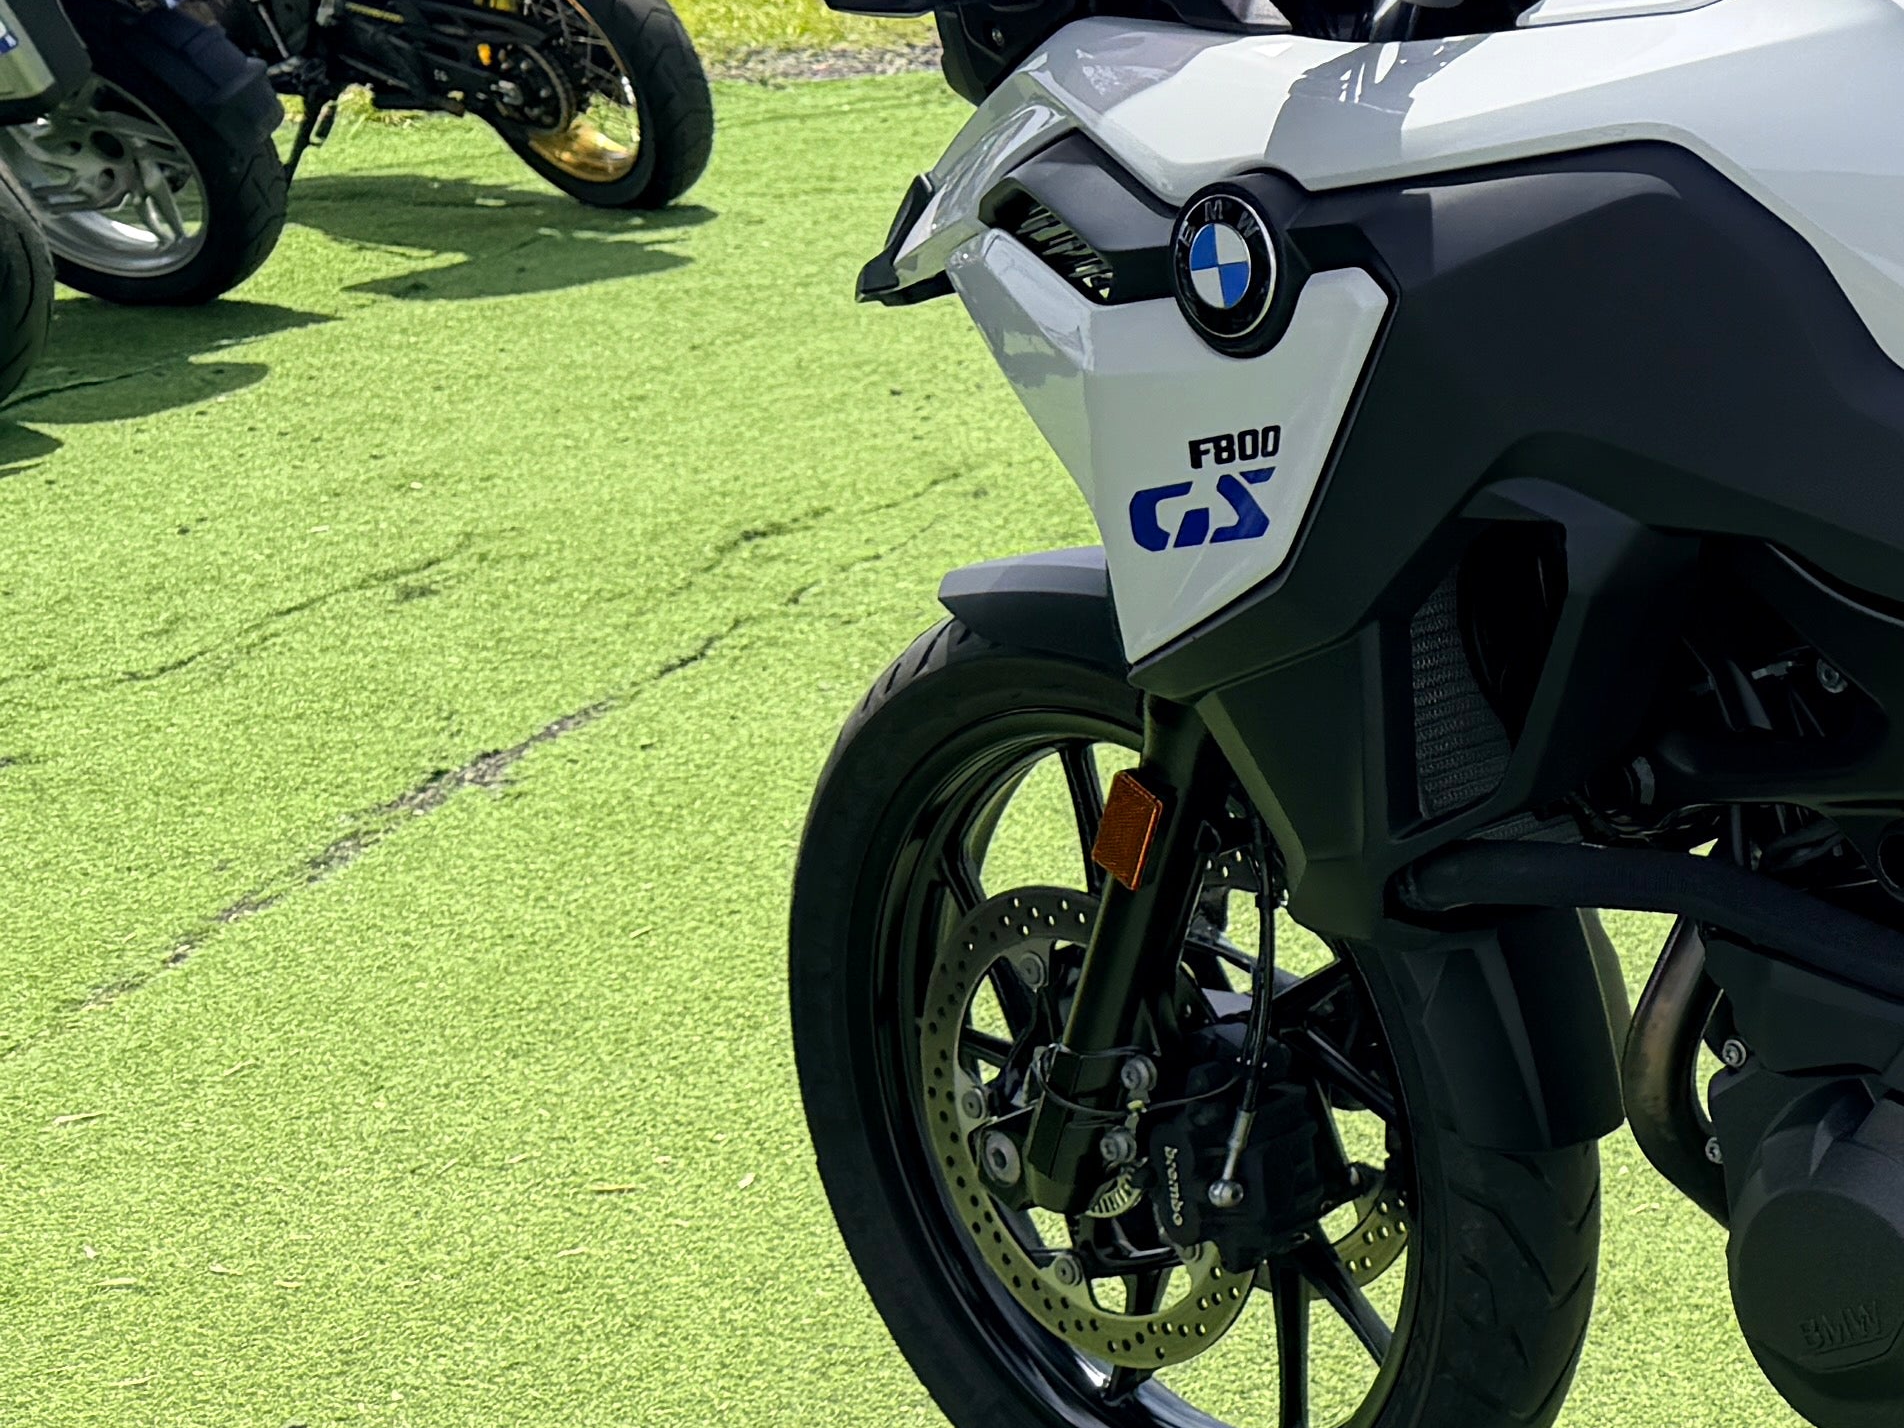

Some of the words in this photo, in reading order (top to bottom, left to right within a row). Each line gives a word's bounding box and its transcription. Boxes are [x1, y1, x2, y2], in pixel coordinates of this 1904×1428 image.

[1178, 198, 1261, 248] BMW
[1187, 424, 1282, 470] F800
[1128, 465, 1277, 552] GS
[1163, 1145, 1185, 1227] brembo
